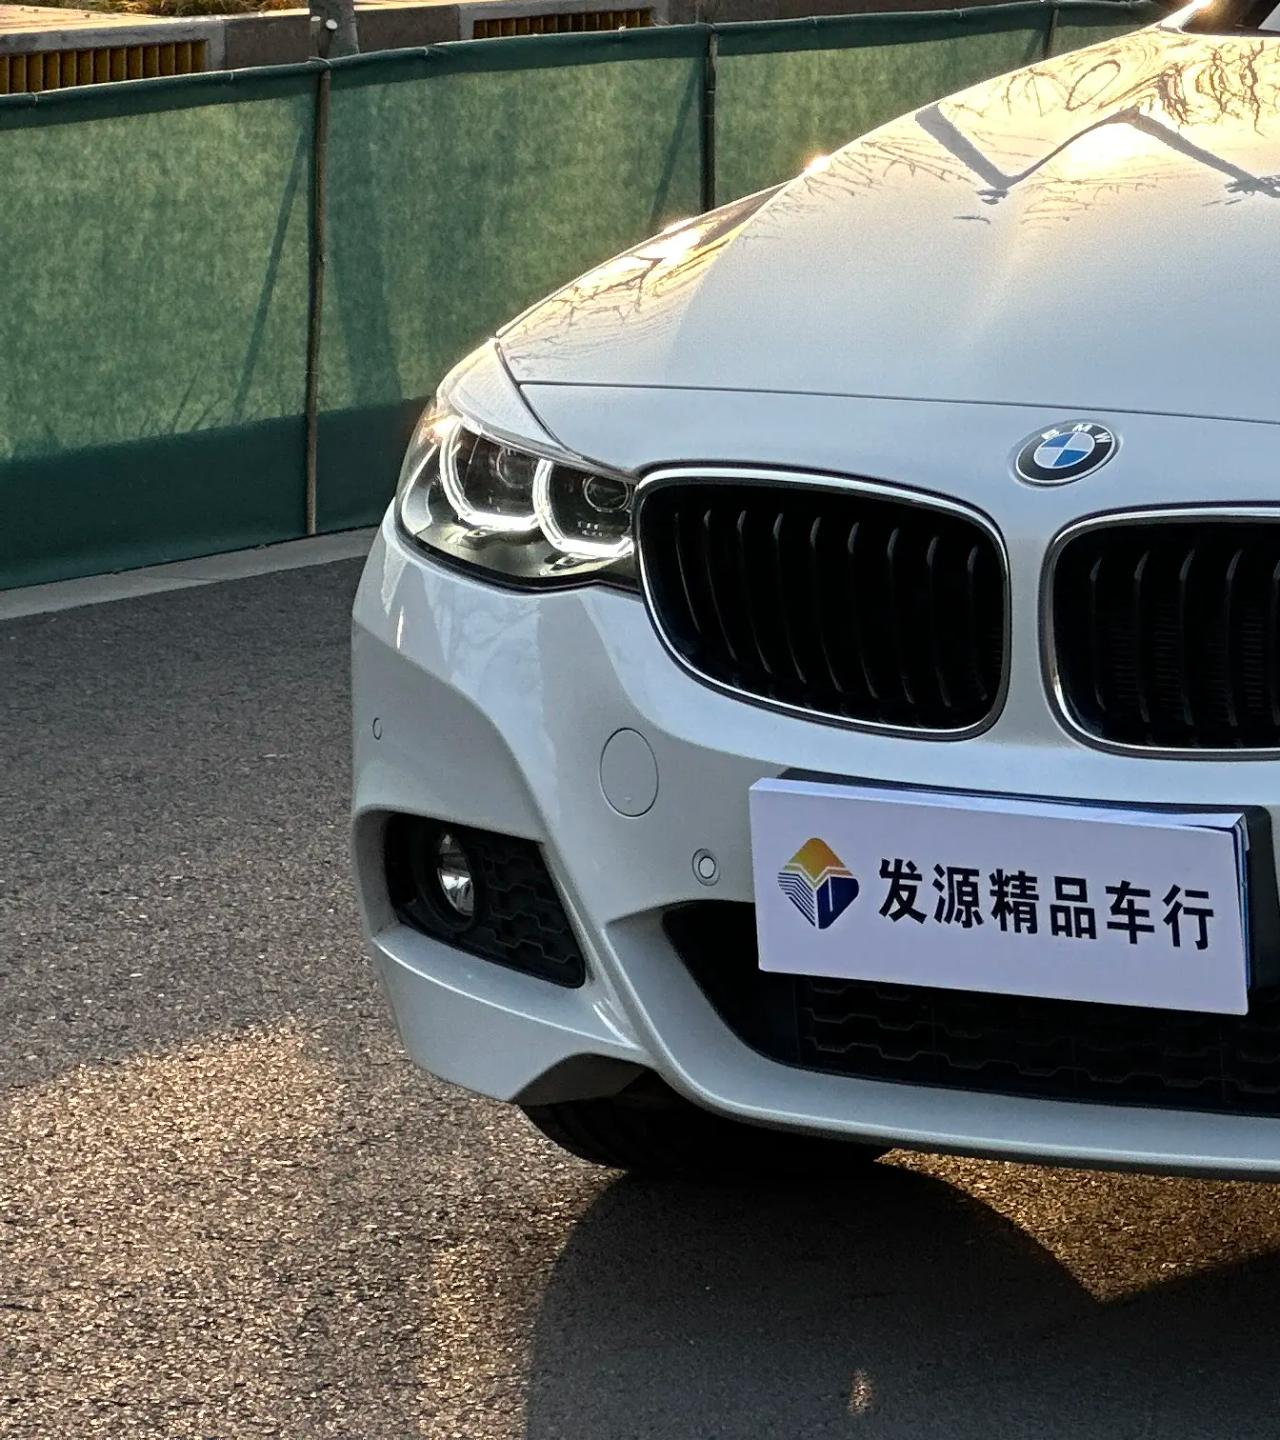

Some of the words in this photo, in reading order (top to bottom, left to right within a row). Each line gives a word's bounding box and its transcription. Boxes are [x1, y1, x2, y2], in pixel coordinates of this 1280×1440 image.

[1041, 423, 1112, 443] BMW
[877, 856, 1215, 951] 发源精品车行
